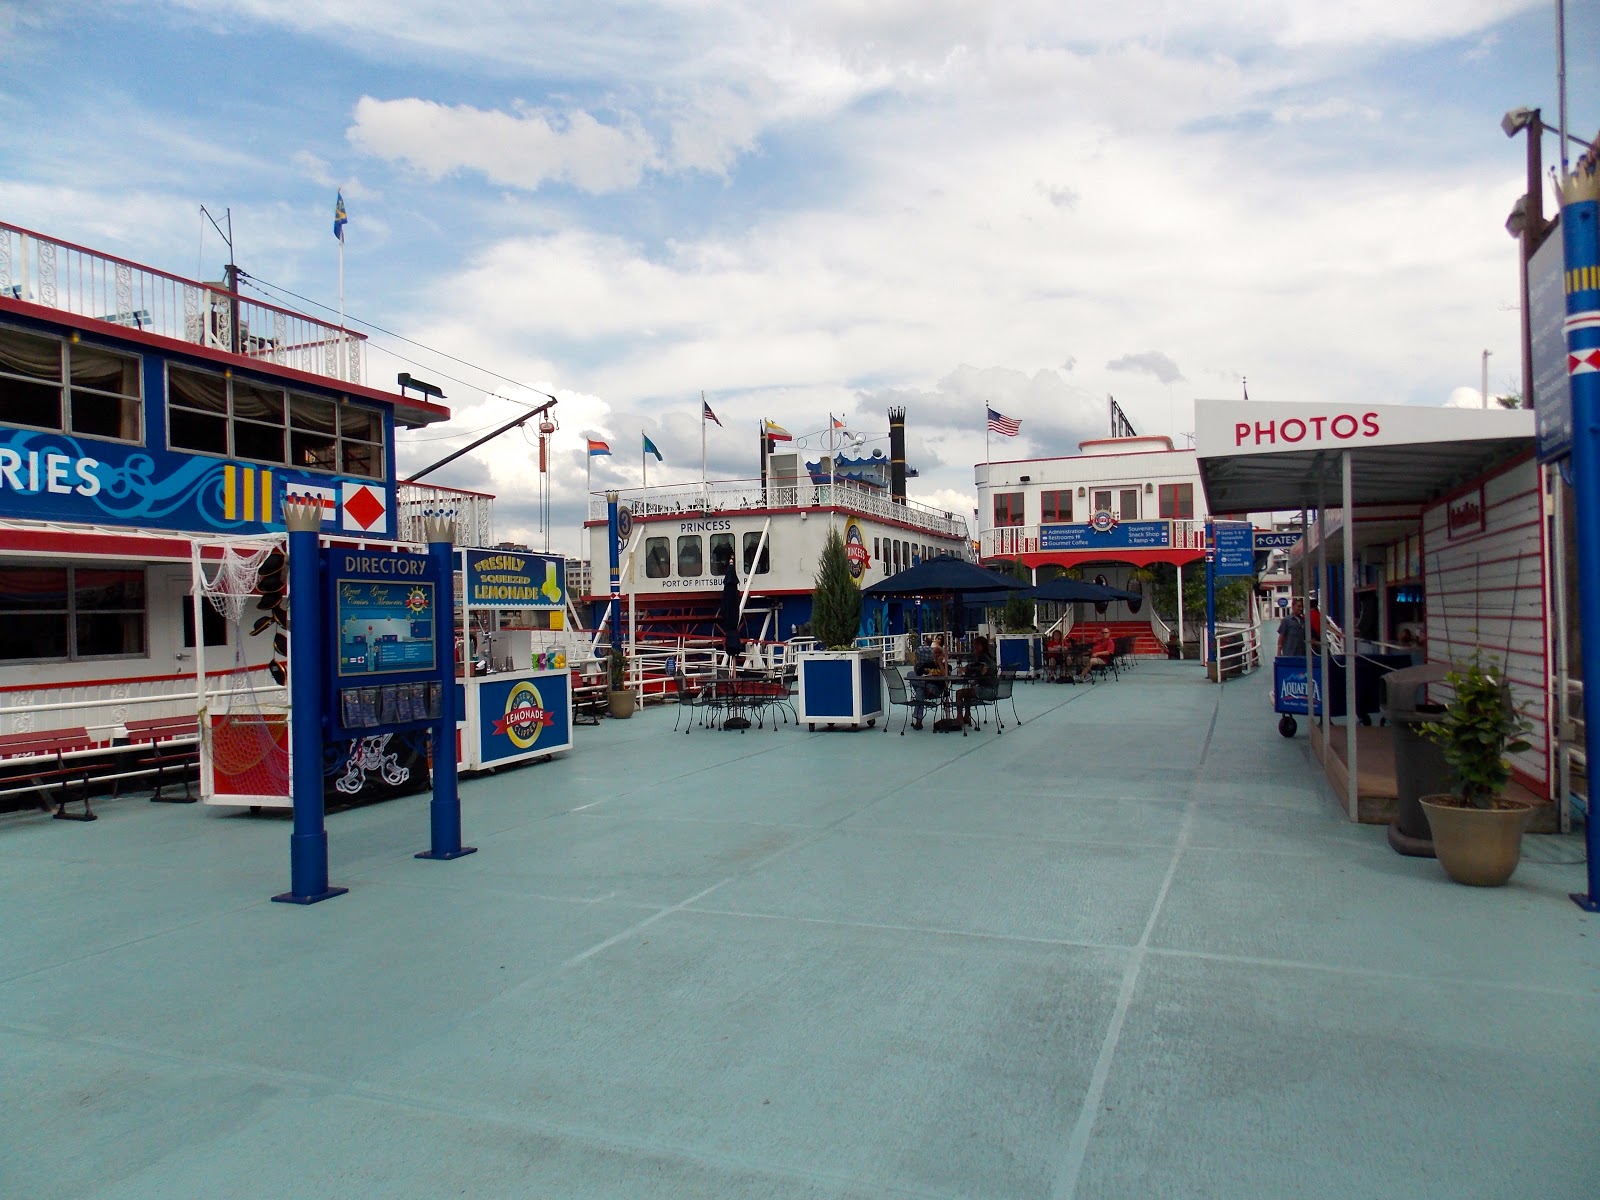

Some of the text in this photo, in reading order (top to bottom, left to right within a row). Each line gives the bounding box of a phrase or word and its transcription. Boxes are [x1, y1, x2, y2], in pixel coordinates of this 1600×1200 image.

[1235, 412, 1380, 447] PHOTOS
[0, 447, 101, 497] RIES
[621, 515, 629, 530] 3
[680, 520, 731, 533] PRINCESS
[1265, 536, 1297, 545] GATES
[345, 556, 426, 575] DIRECTORY
[474, 556, 526, 572] FRESHLY
[480, 574, 531, 585] SQUEEZED
[662, 579, 682, 588] PORT
[683, 579, 693, 587] OF
[475, 584, 539, 600] LEMONADE
[1280, 678, 1321, 702] AQUAFIA
[513, 692, 537, 709] GATEWAY
[506, 710, 544, 725] LEMONADE
[514, 722, 537, 737] CLIPPER
